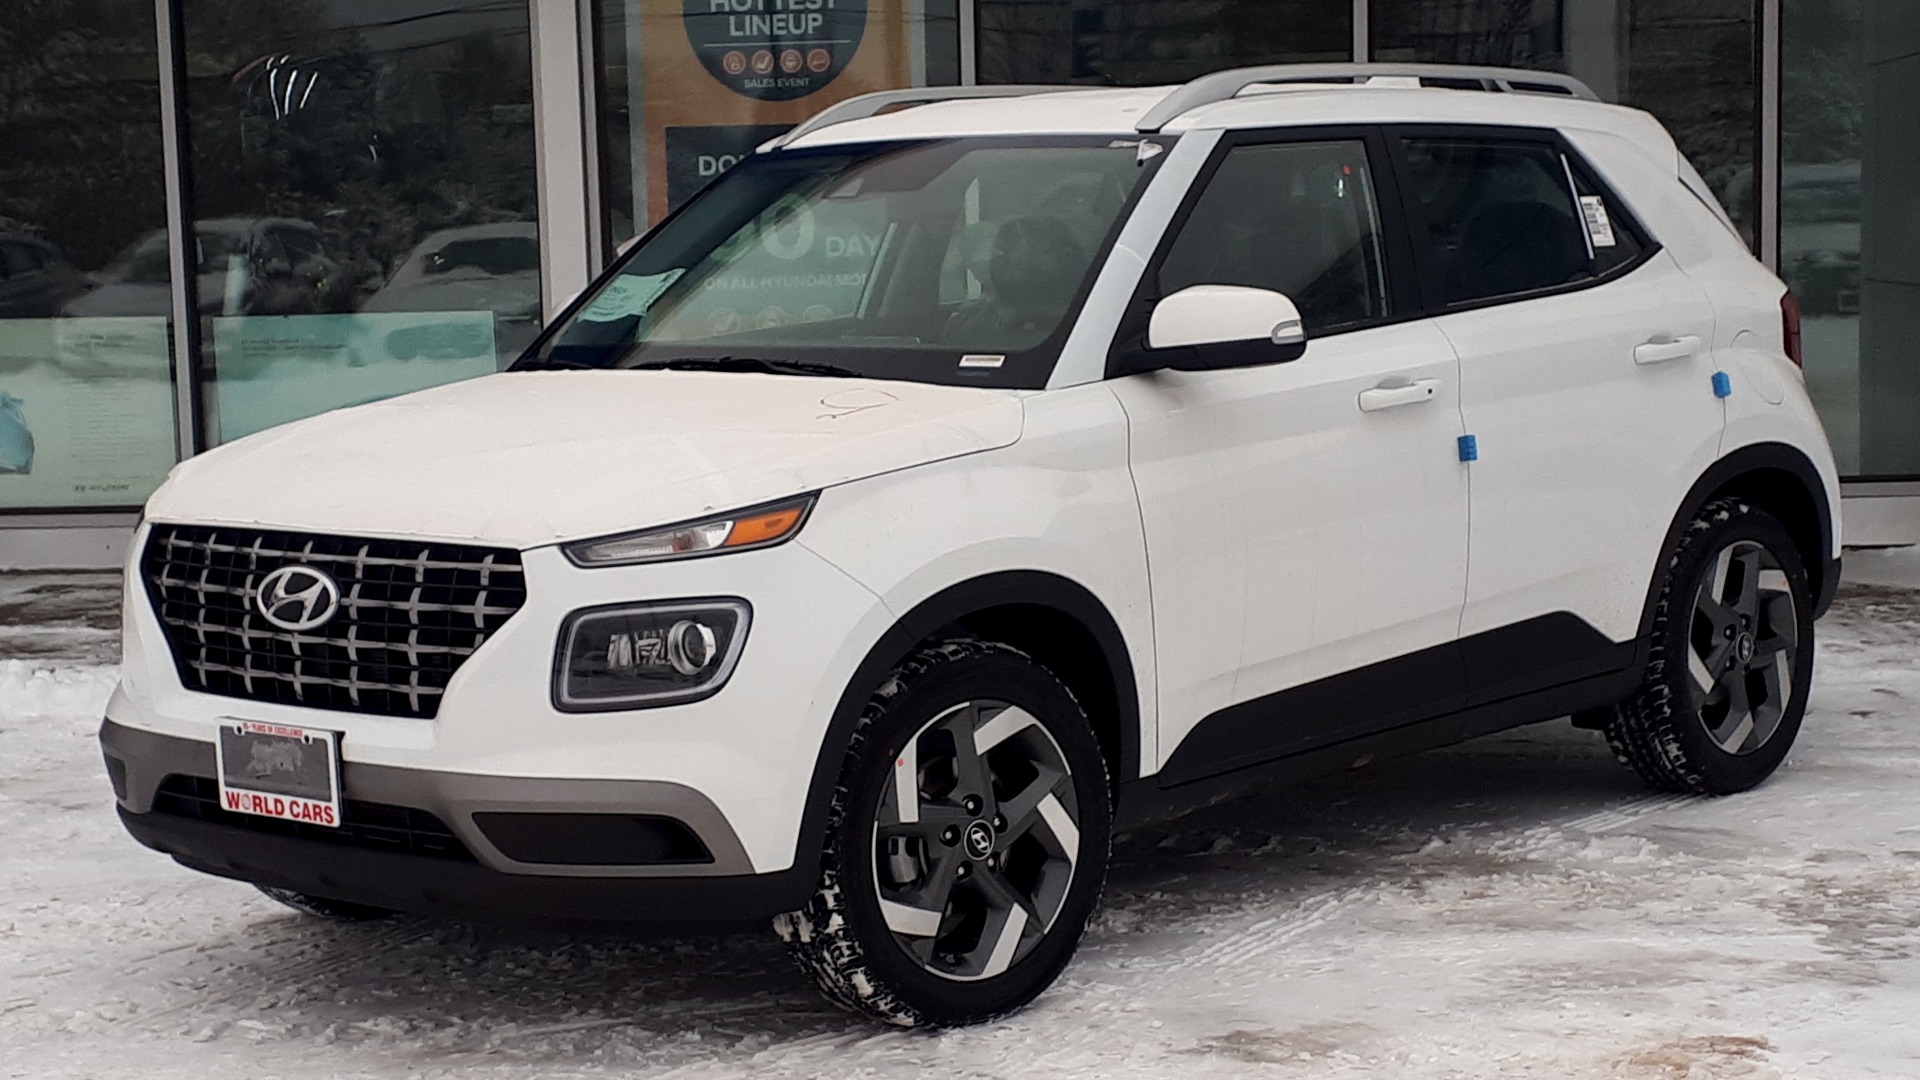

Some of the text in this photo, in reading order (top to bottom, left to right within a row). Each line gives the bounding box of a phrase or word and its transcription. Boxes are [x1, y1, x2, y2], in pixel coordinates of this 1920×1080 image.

[728, 13, 823, 37] LINEUP
[744, 77, 811, 88] SALES EVENT
[698, 155, 745, 176] DO
[731, 276, 756, 290] ALL
[225, 791, 334, 824] WORLD CARS
